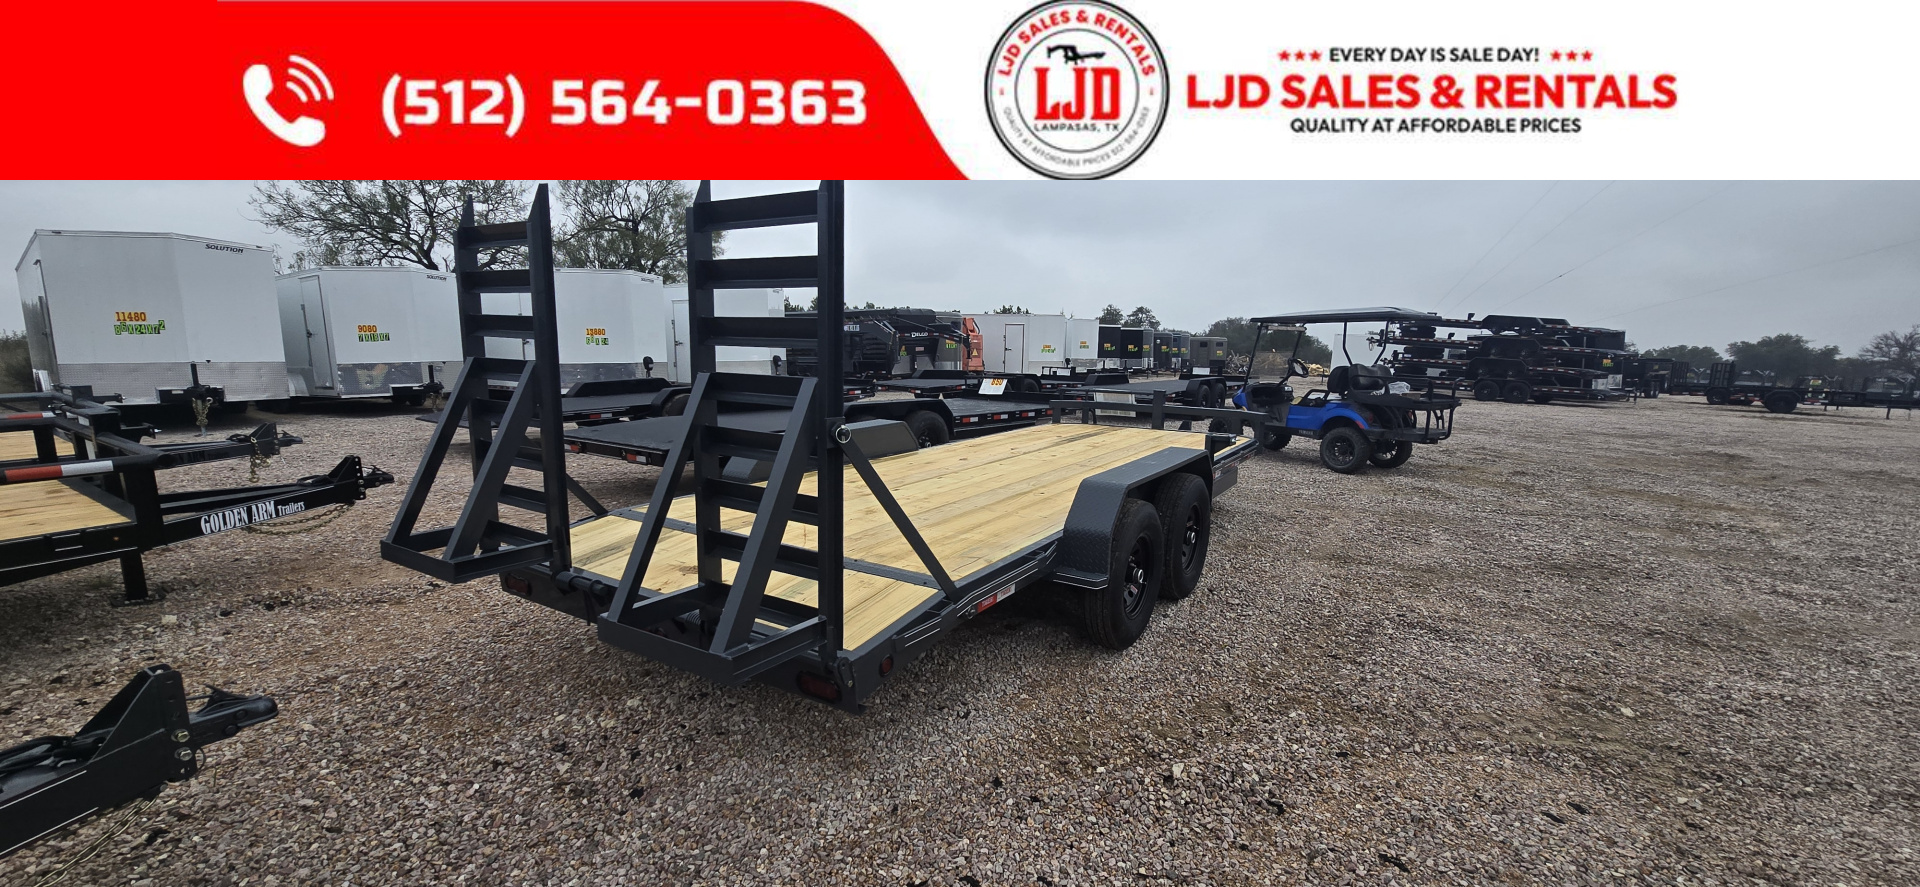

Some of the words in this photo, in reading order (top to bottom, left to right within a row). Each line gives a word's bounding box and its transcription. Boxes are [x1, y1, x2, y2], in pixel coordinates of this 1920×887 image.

[205, 243, 244, 254] SOLUTION
[115, 311, 147, 322] 11480
[357, 324, 378, 333] 9080
[200, 507, 249, 535] GOLDEN
[251, 500, 276, 523] ARM
[277, 501, 305, 517] Trailers
